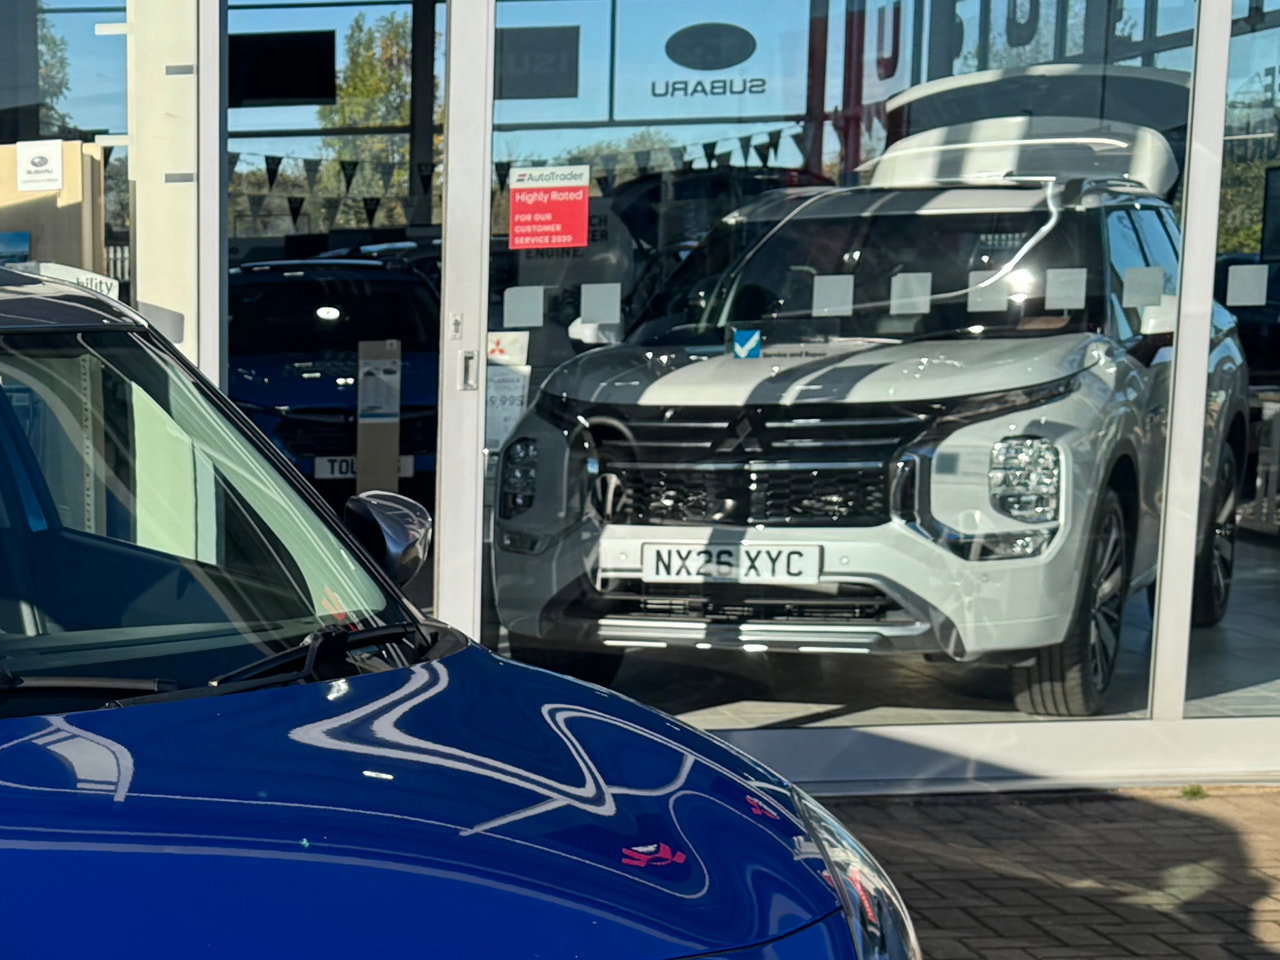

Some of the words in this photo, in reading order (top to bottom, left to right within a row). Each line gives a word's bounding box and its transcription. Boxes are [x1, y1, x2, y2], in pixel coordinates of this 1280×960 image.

[527, 171, 584, 182] AutoTrader
[515, 191, 550, 205] Highly
[550, 190, 584, 201] Rated
[514, 213, 532, 222] FOR
[533, 213, 552, 222] OUR
[514, 224, 561, 233] CUSTOMER
[514, 236, 549, 245] SERVICE
[744, 550, 803, 578] XYC
